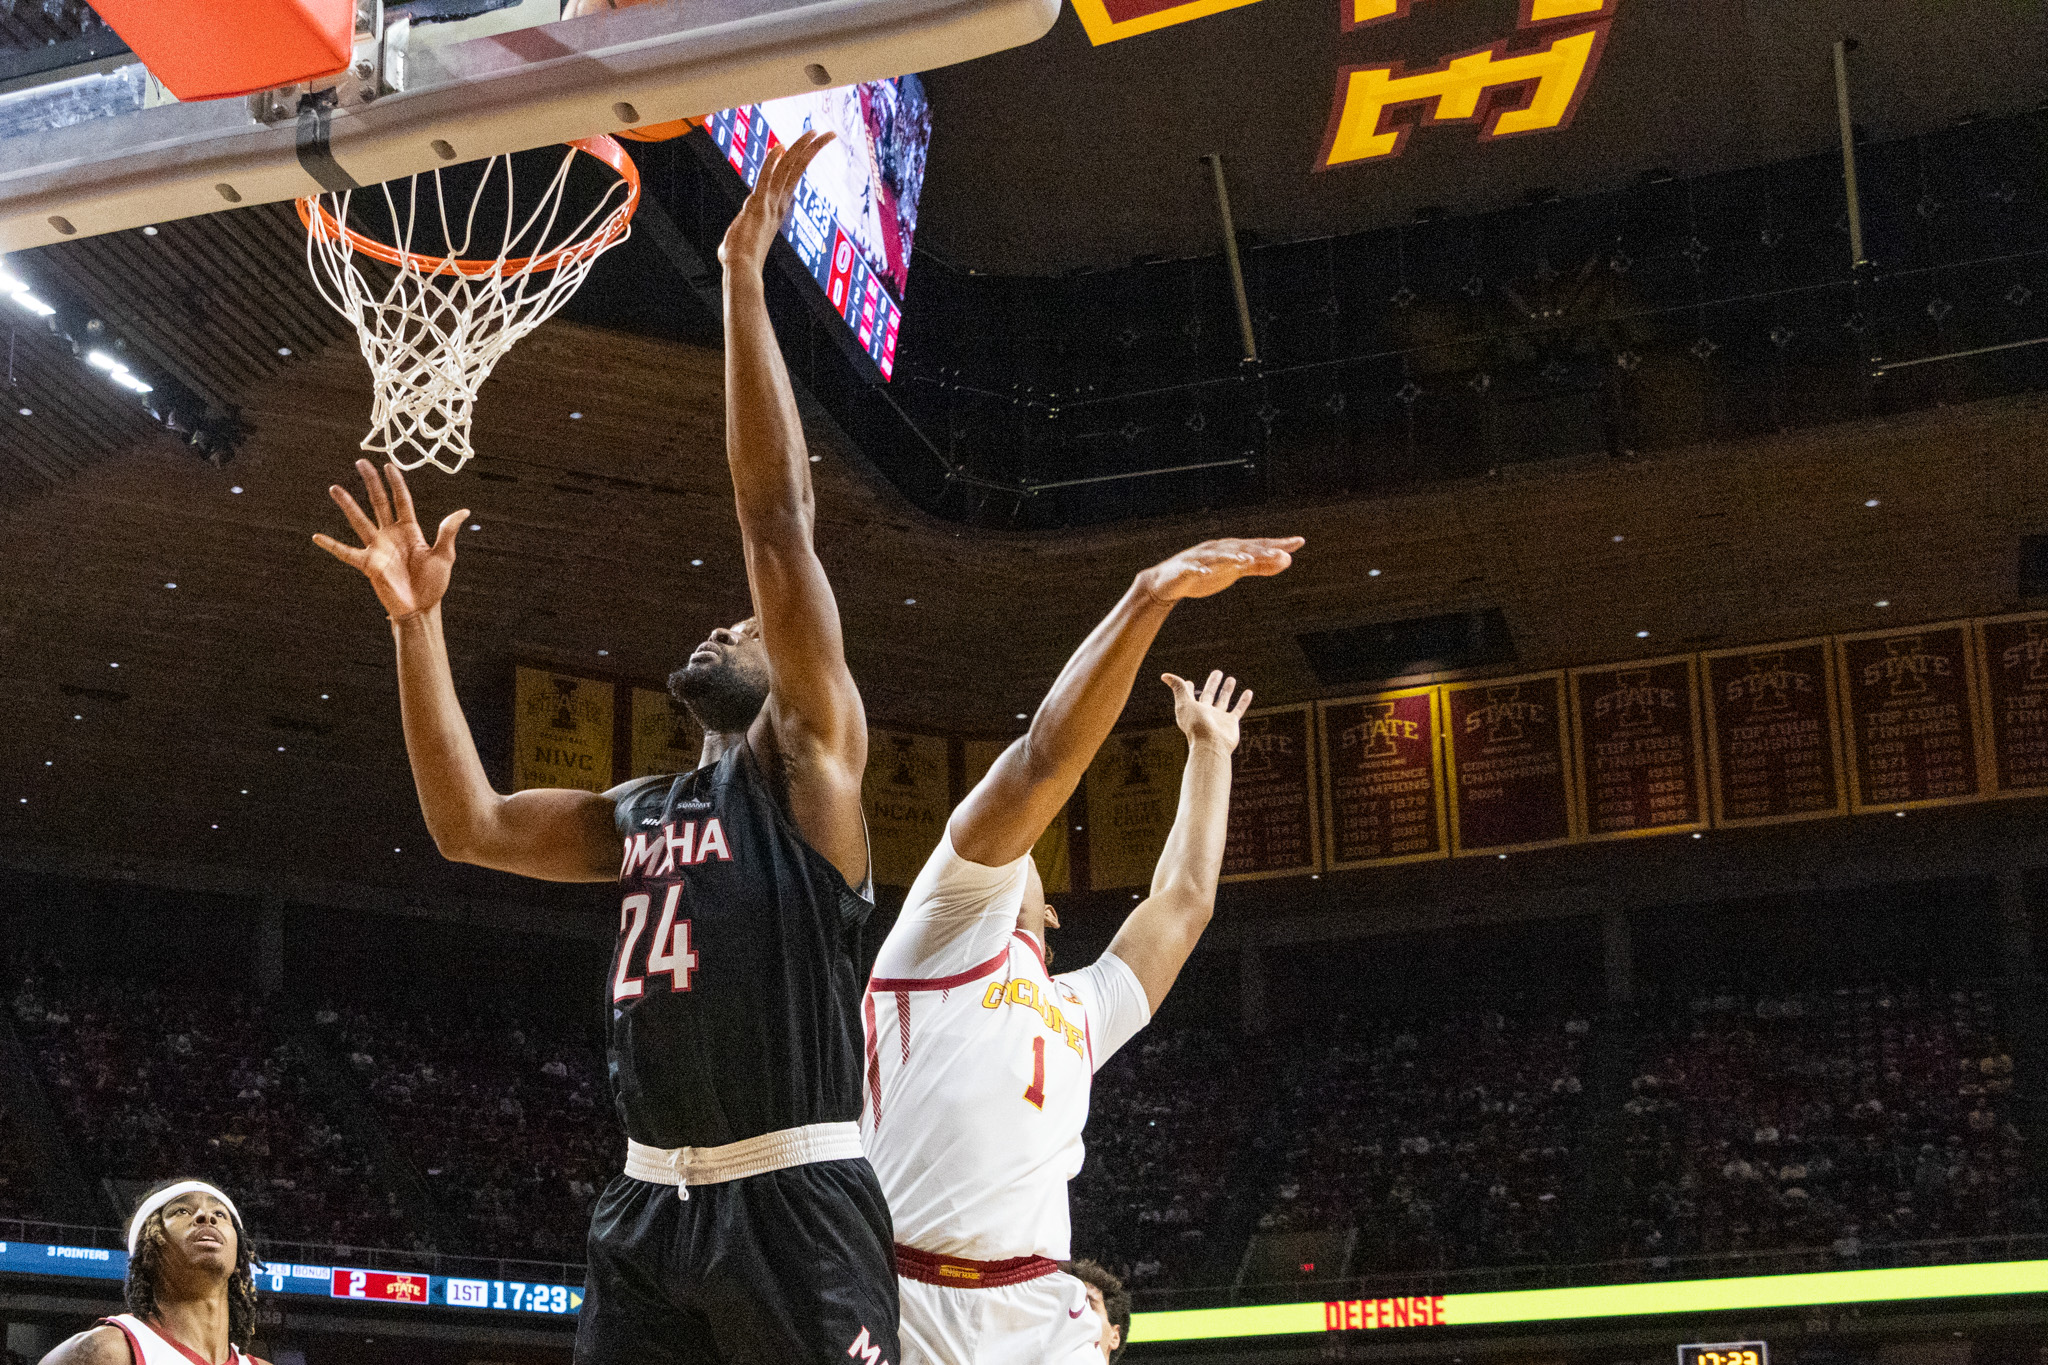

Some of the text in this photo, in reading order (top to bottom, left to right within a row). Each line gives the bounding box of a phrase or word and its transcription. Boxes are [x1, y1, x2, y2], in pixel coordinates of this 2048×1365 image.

[747, 167, 755, 187] 2
[793, 175, 831, 239] 17:23
[857, 263, 865, 282] 0
[832, 277, 843, 307] 0
[854, 287, 861, 305] 2
[880, 296, 887, 314] 0
[850, 309, 856, 328] 1
[876, 319, 883, 337] 2
[873, 342, 879, 360] 1
[1864, 654, 1952, 686] STATE
[1594, 686, 1676, 719] STATE
[1465, 702, 1546, 734] STATE
[1342, 717, 1420, 750] STATE
[535, 746, 593, 771] NIVC
[1337, 767, 1428, 787] CONFERENCE
[1336, 778, 1430, 799] CHAMPIONS
[613, 880, 700, 1003] 24
[1022, 1035, 1046, 1112] 1
[47, 1246, 110, 1261] 3 POINTERS
[271, 1274, 284, 1292] 0
[294, 1266, 329, 1280] BONUS
[349, 1271, 367, 1298] 2
[386, 1281, 422, 1297] STATE
[453, 1281, 568, 1314] 1ST 17:23
[1324, 1296, 1447, 1331] DEFENSE
